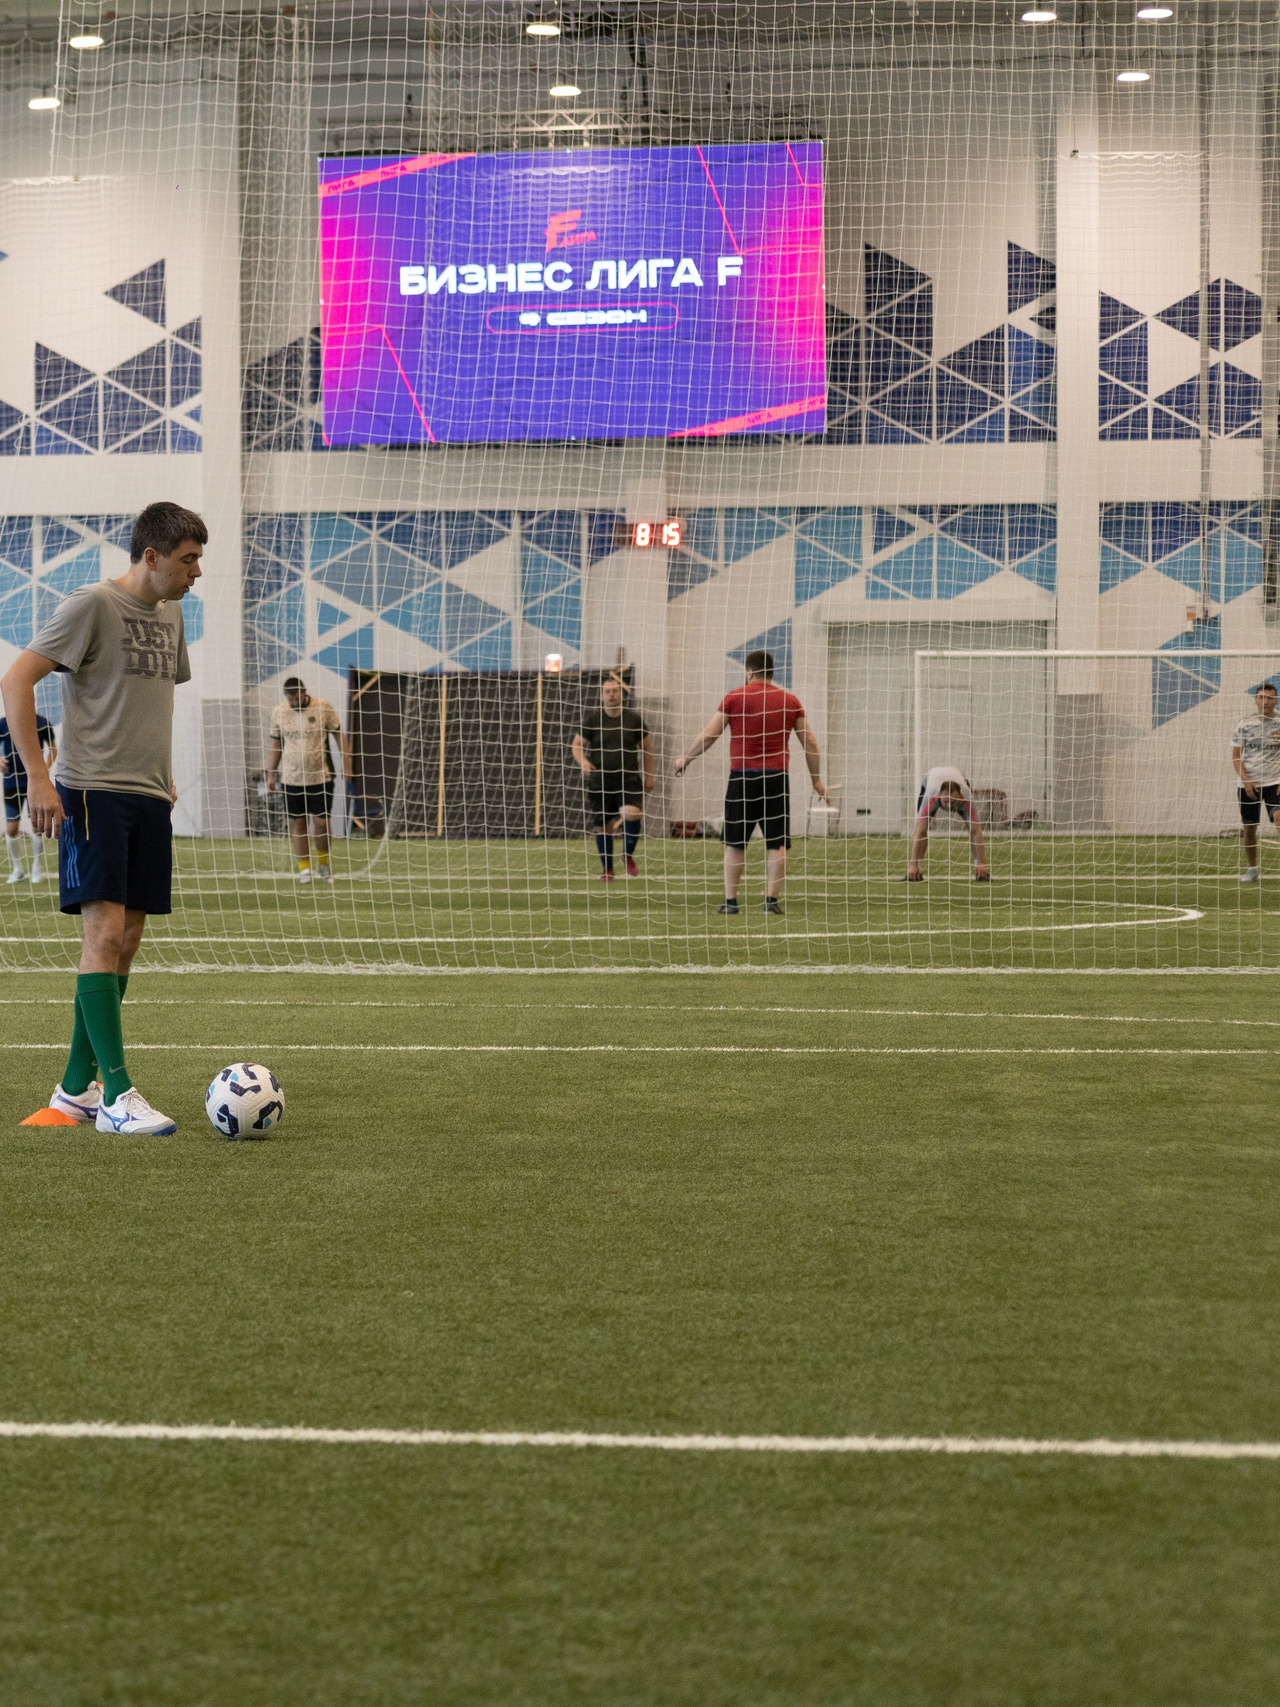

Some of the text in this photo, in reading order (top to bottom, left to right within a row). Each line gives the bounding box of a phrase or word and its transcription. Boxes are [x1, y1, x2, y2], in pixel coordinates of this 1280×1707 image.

[327, 179, 355, 194] ЛИГА
[399, 256, 744, 296] БИЗНЕС ЛИГА F
[636, 522, 680, 546] 8 15
